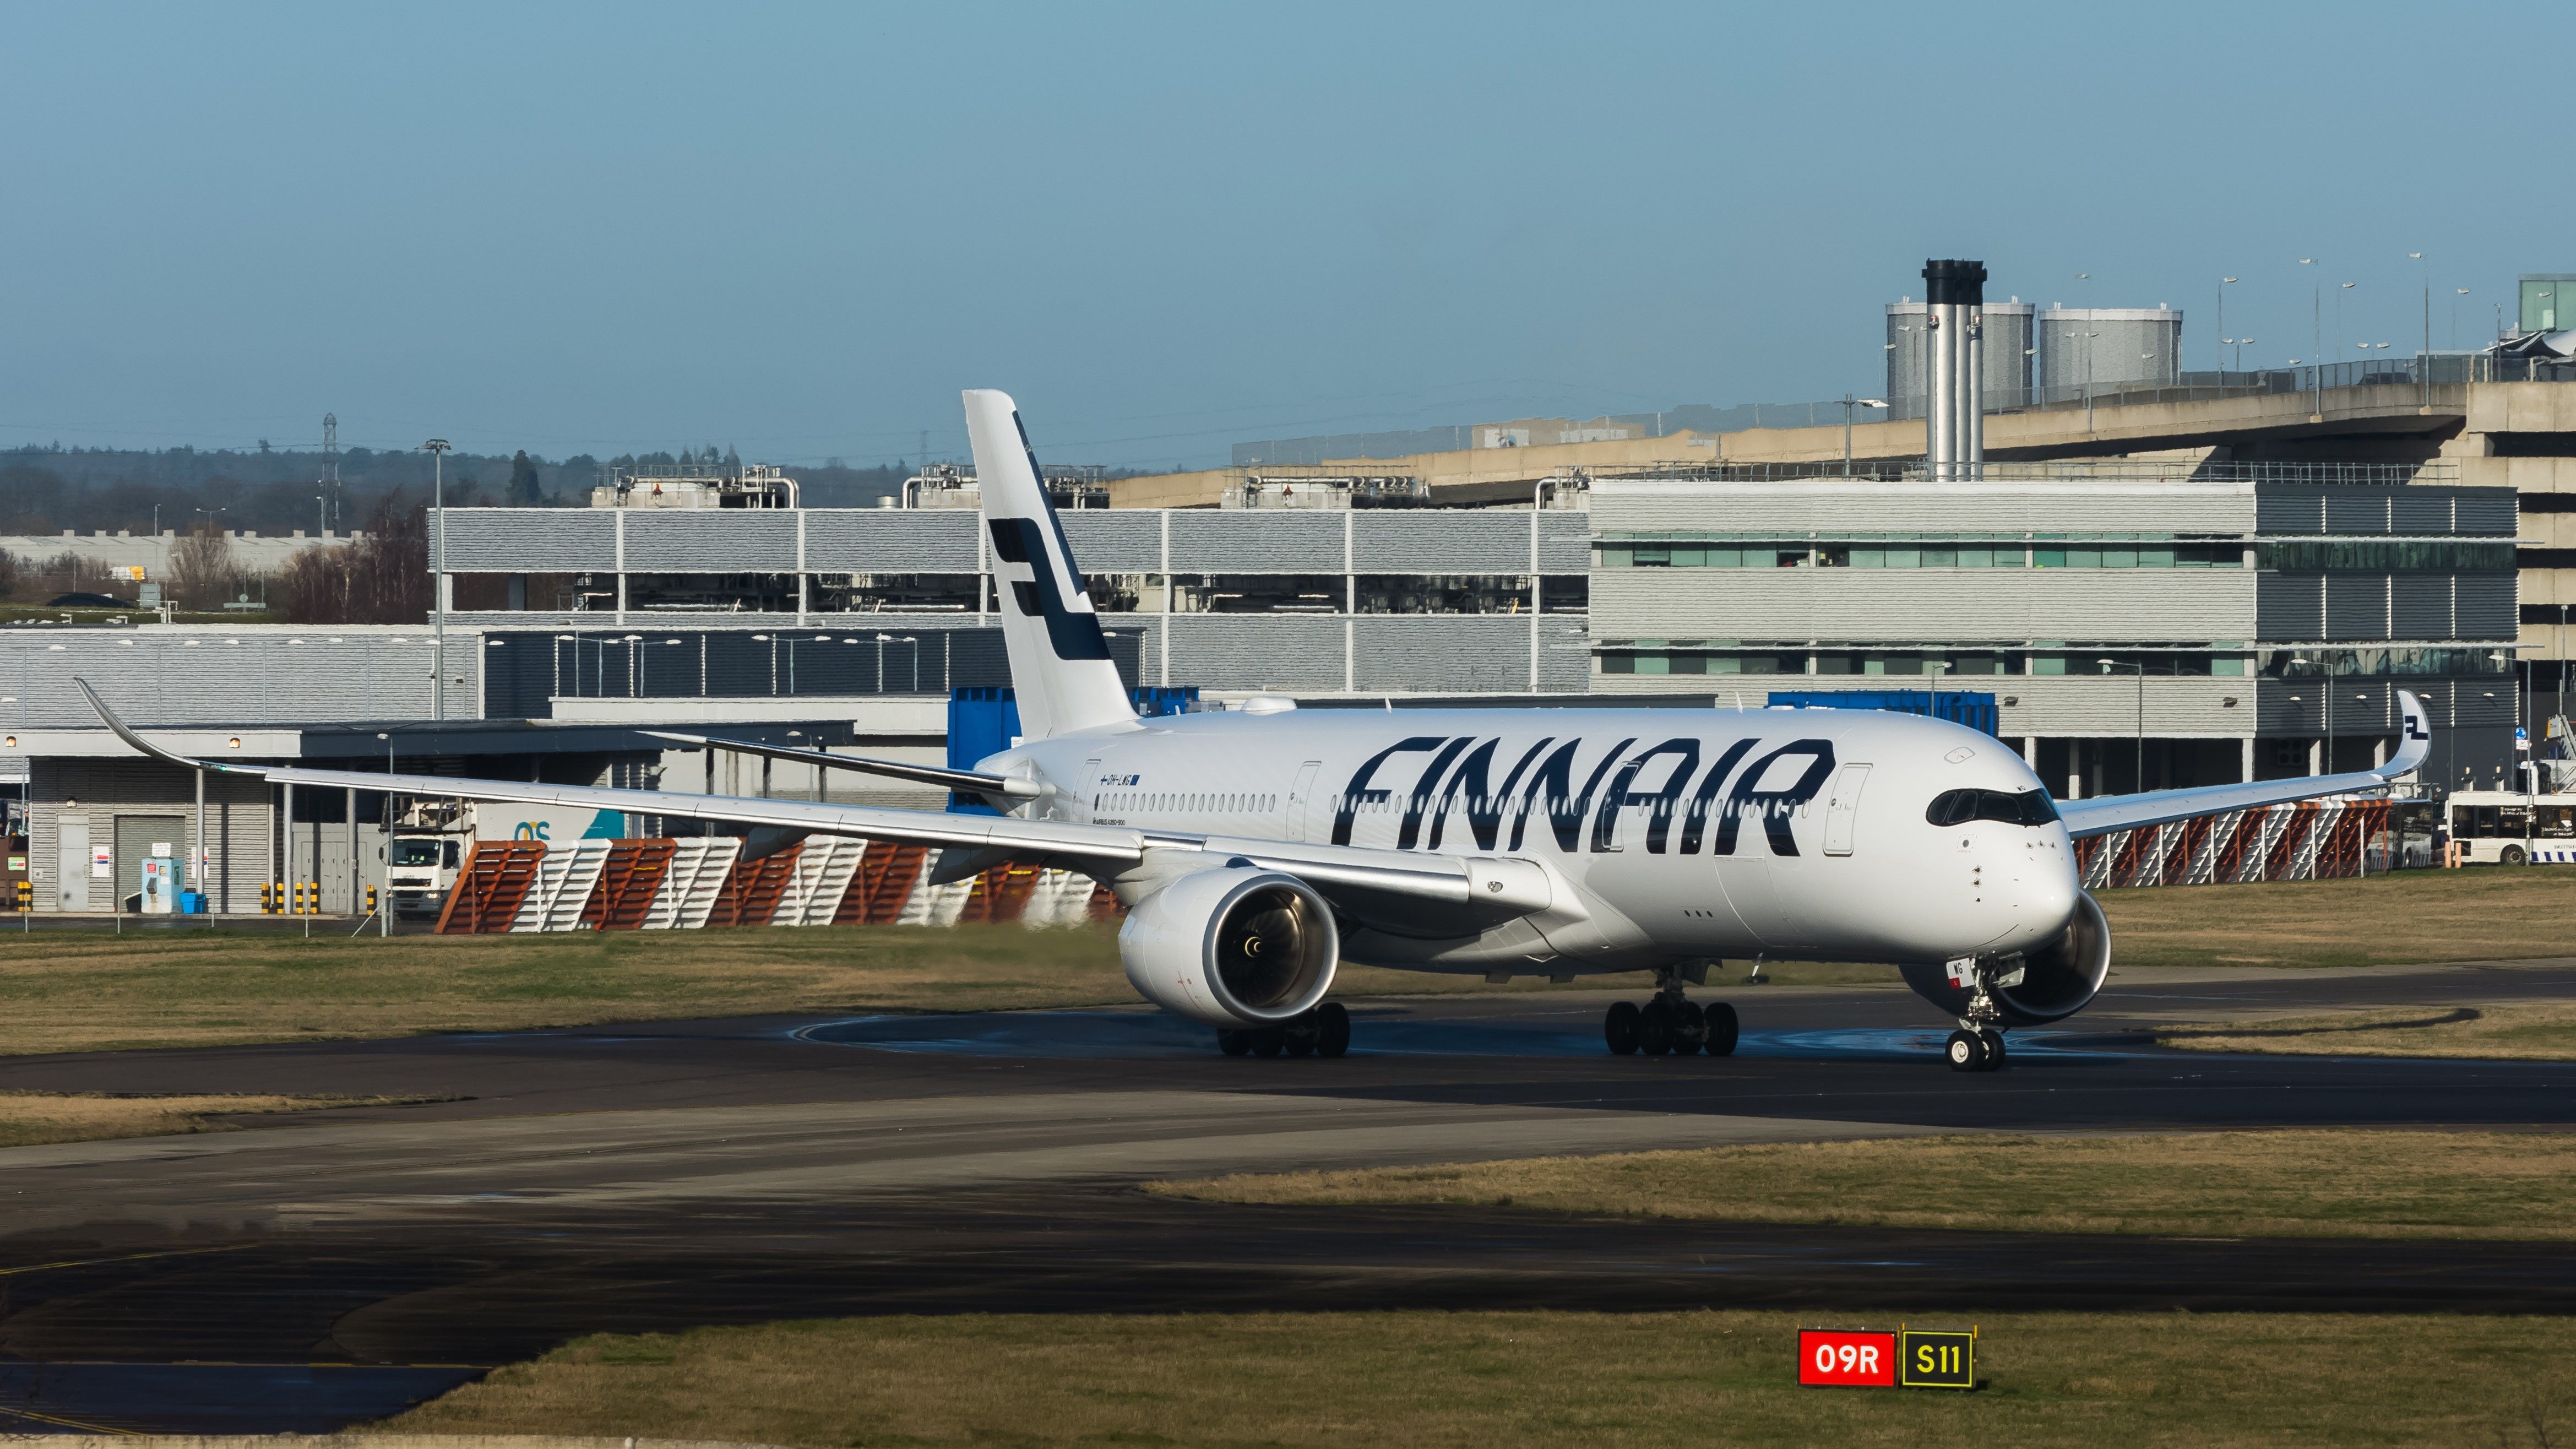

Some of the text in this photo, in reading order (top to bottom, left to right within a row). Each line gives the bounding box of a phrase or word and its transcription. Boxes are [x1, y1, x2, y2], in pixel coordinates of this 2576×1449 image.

[1107, 774, 1132, 785] OH-LWG
[1331, 736, 1836, 857] FINNAIR
[1953, 962, 1963, 975] WG
[1816, 1344, 1878, 1374] 09R
[1917, 1345, 1959, 1373] S11
